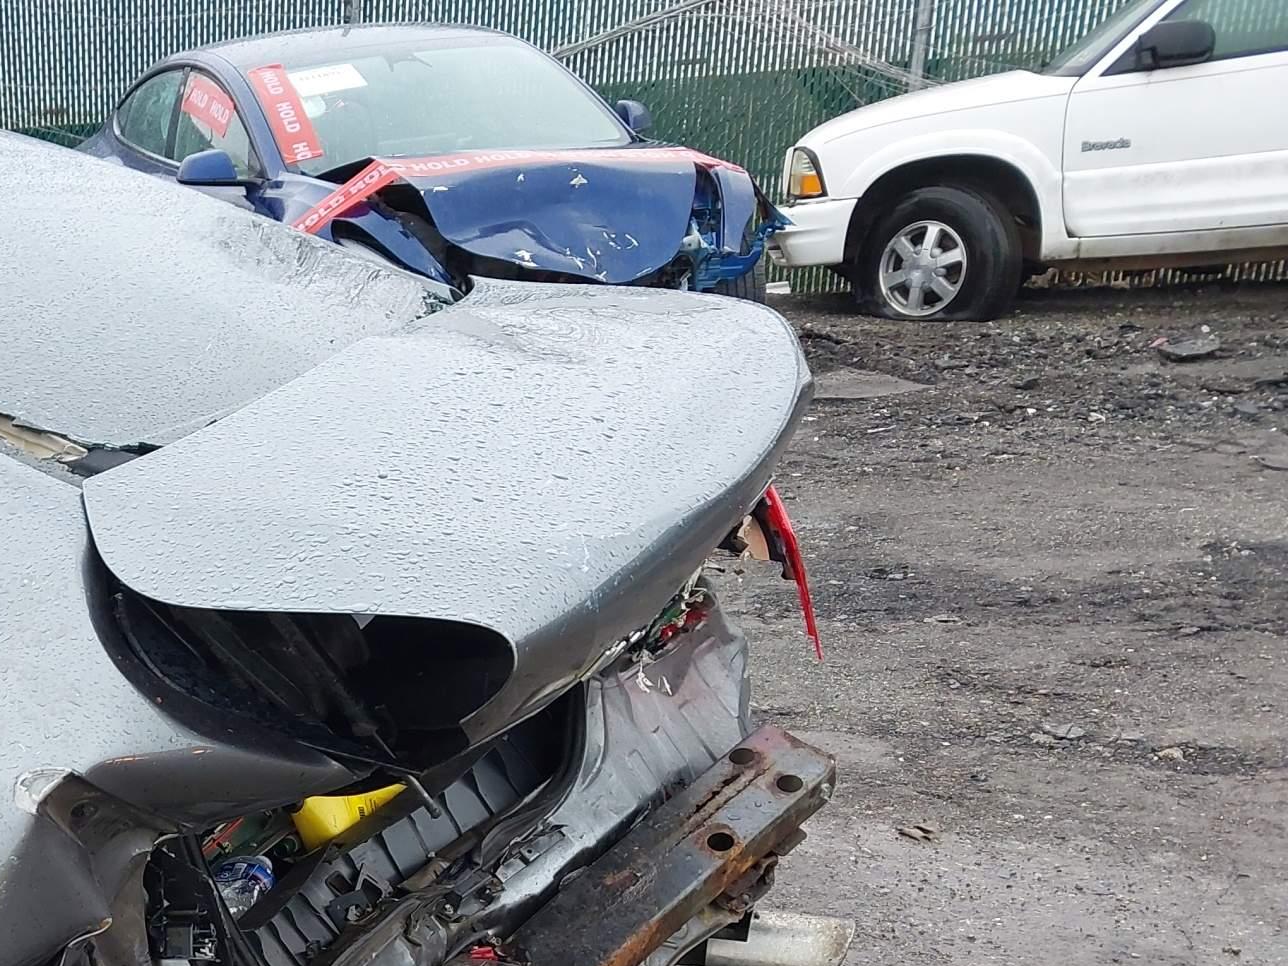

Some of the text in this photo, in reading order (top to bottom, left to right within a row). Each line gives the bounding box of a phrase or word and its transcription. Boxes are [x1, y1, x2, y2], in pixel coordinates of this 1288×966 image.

[190, 87, 230, 124] HOLD HOLD
[259, 70, 284, 95] HOLD
[276, 101, 301, 132] HOLD
[411, 158, 469, 172] HOLD
